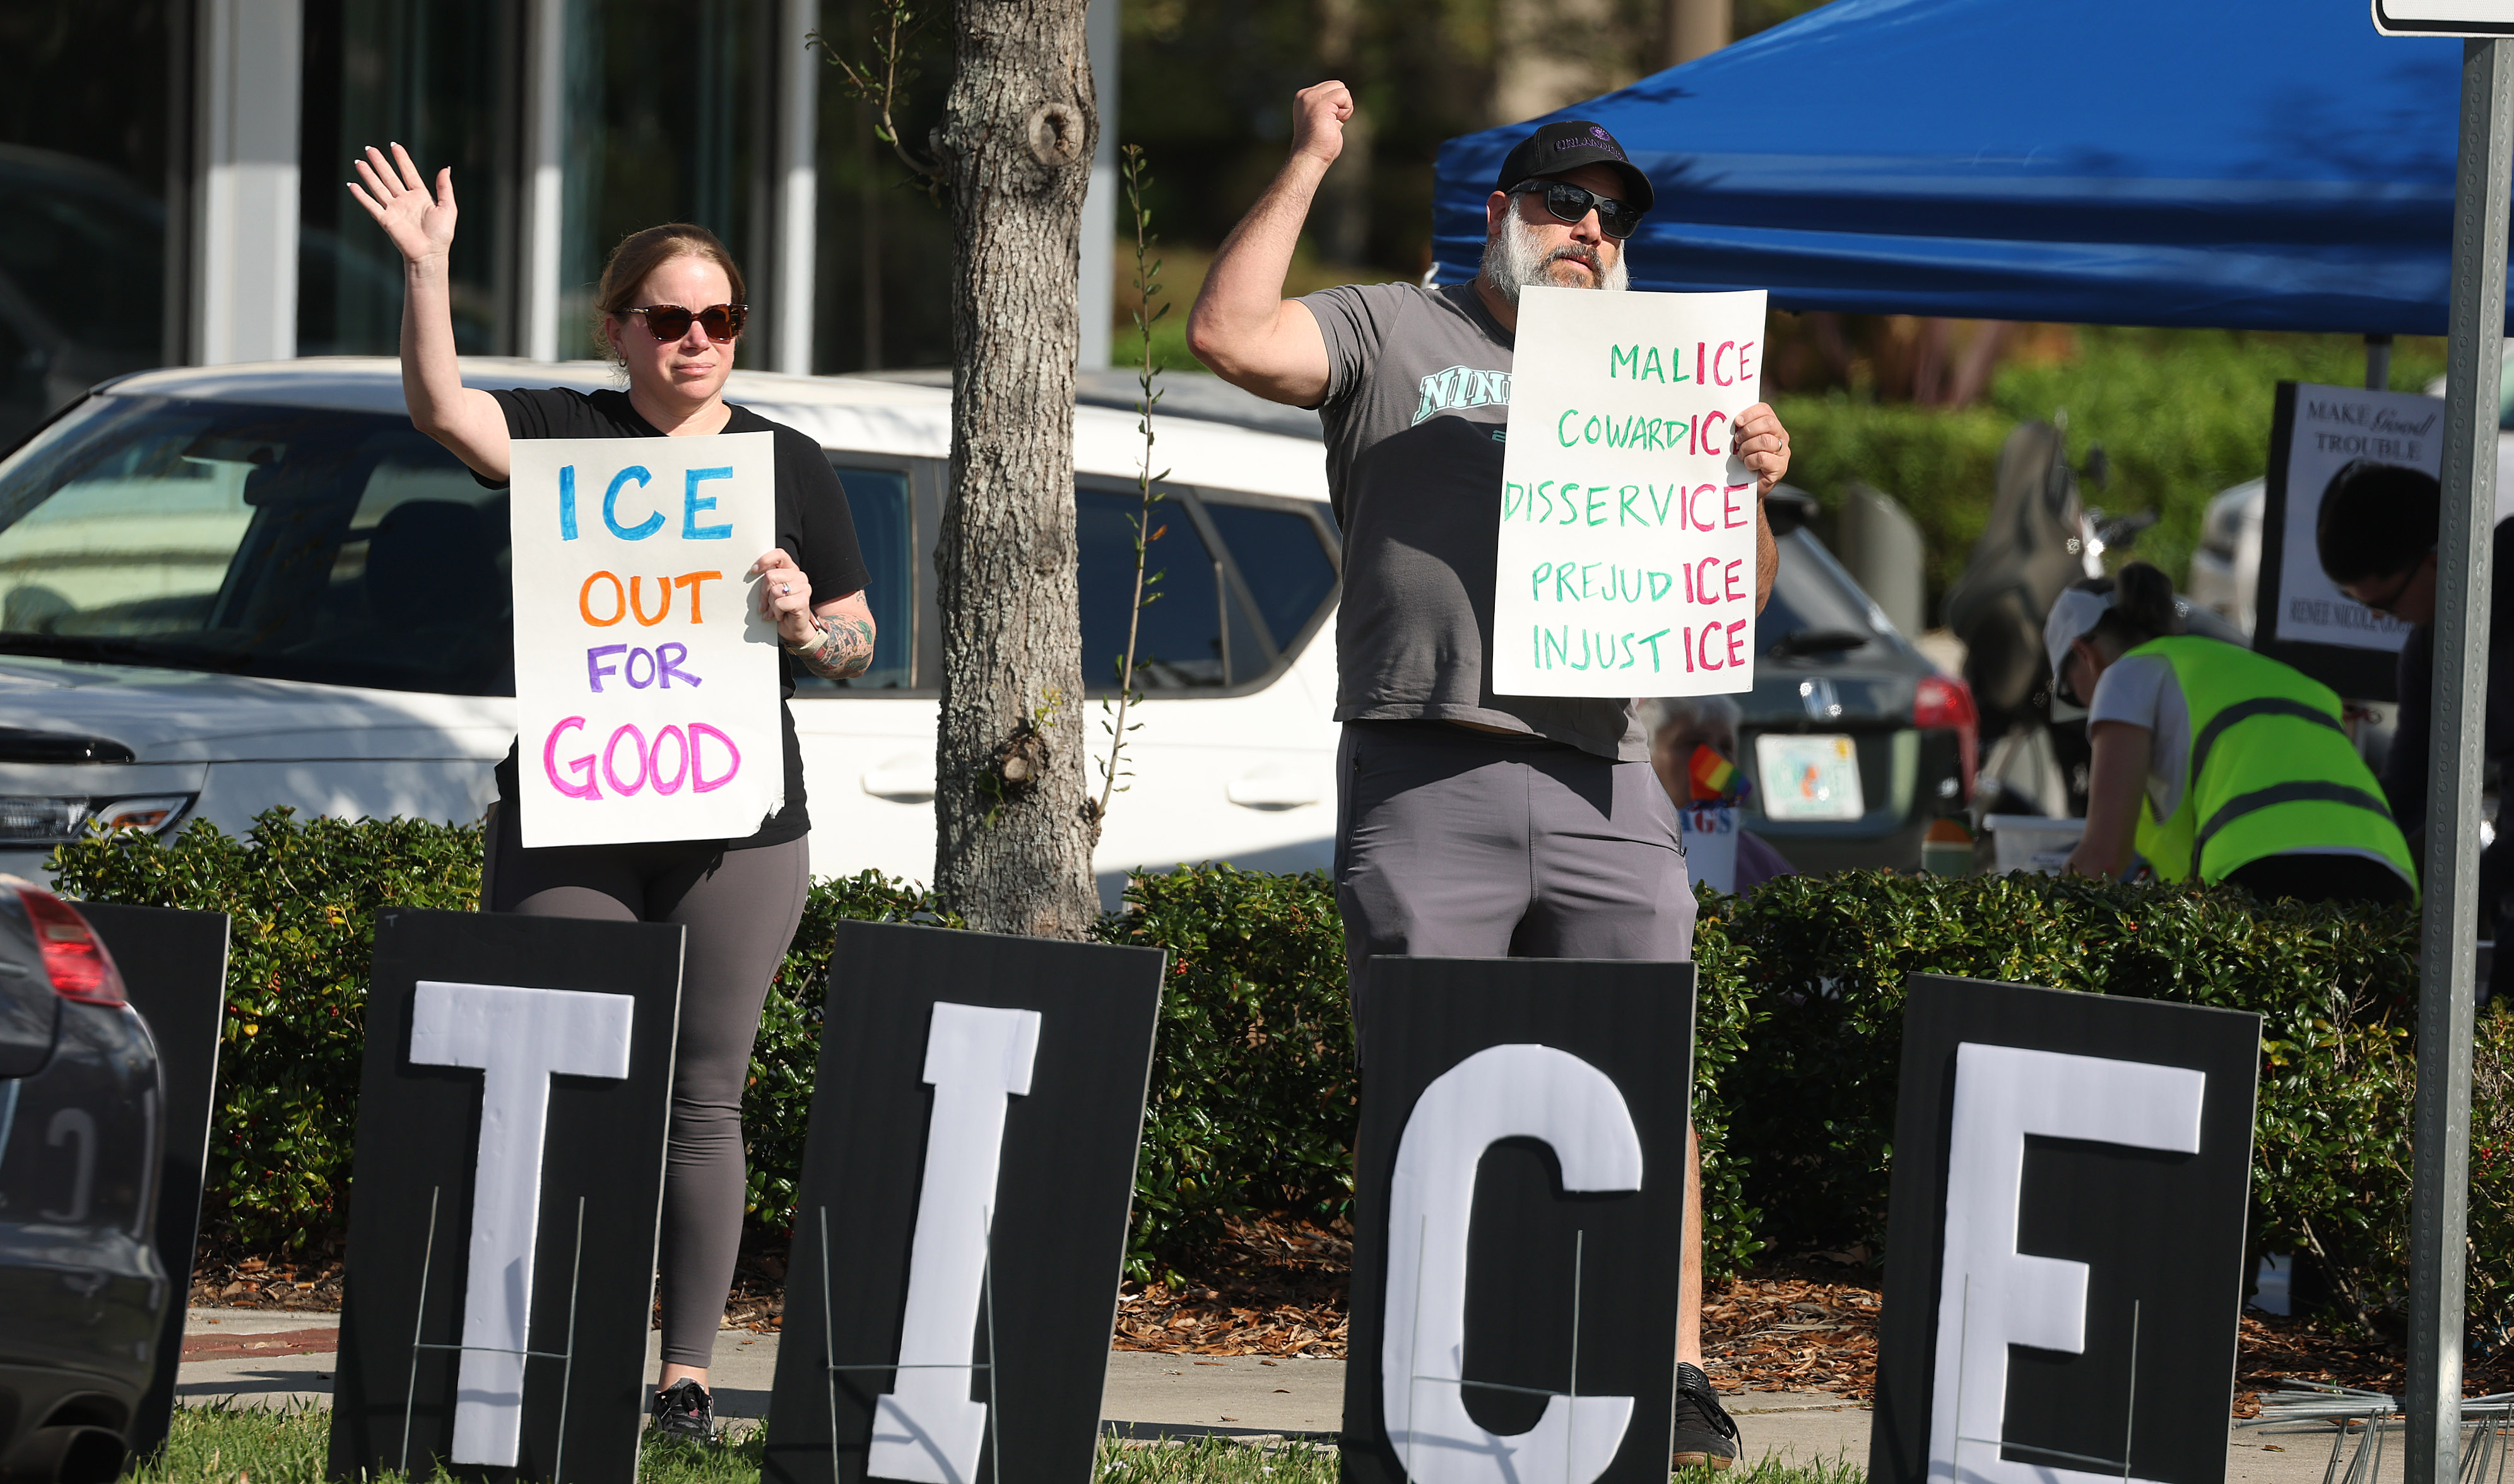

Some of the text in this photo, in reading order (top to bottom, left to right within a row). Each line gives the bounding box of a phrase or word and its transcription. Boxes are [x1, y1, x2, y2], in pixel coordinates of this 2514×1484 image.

[1610, 341, 1755, 387] MALICE
[1411, 365, 1513, 427] NIN
[2306, 400, 2436, 437] MAKE Good
[2315, 432, 2421, 461] TROUBLE
[559, 464, 733, 541] ICE
[1504, 480, 1749, 532] DISSERVICE
[579, 570, 723, 627] OUT
[587, 642, 703, 693] FOR
[543, 716, 741, 800] GOOD
